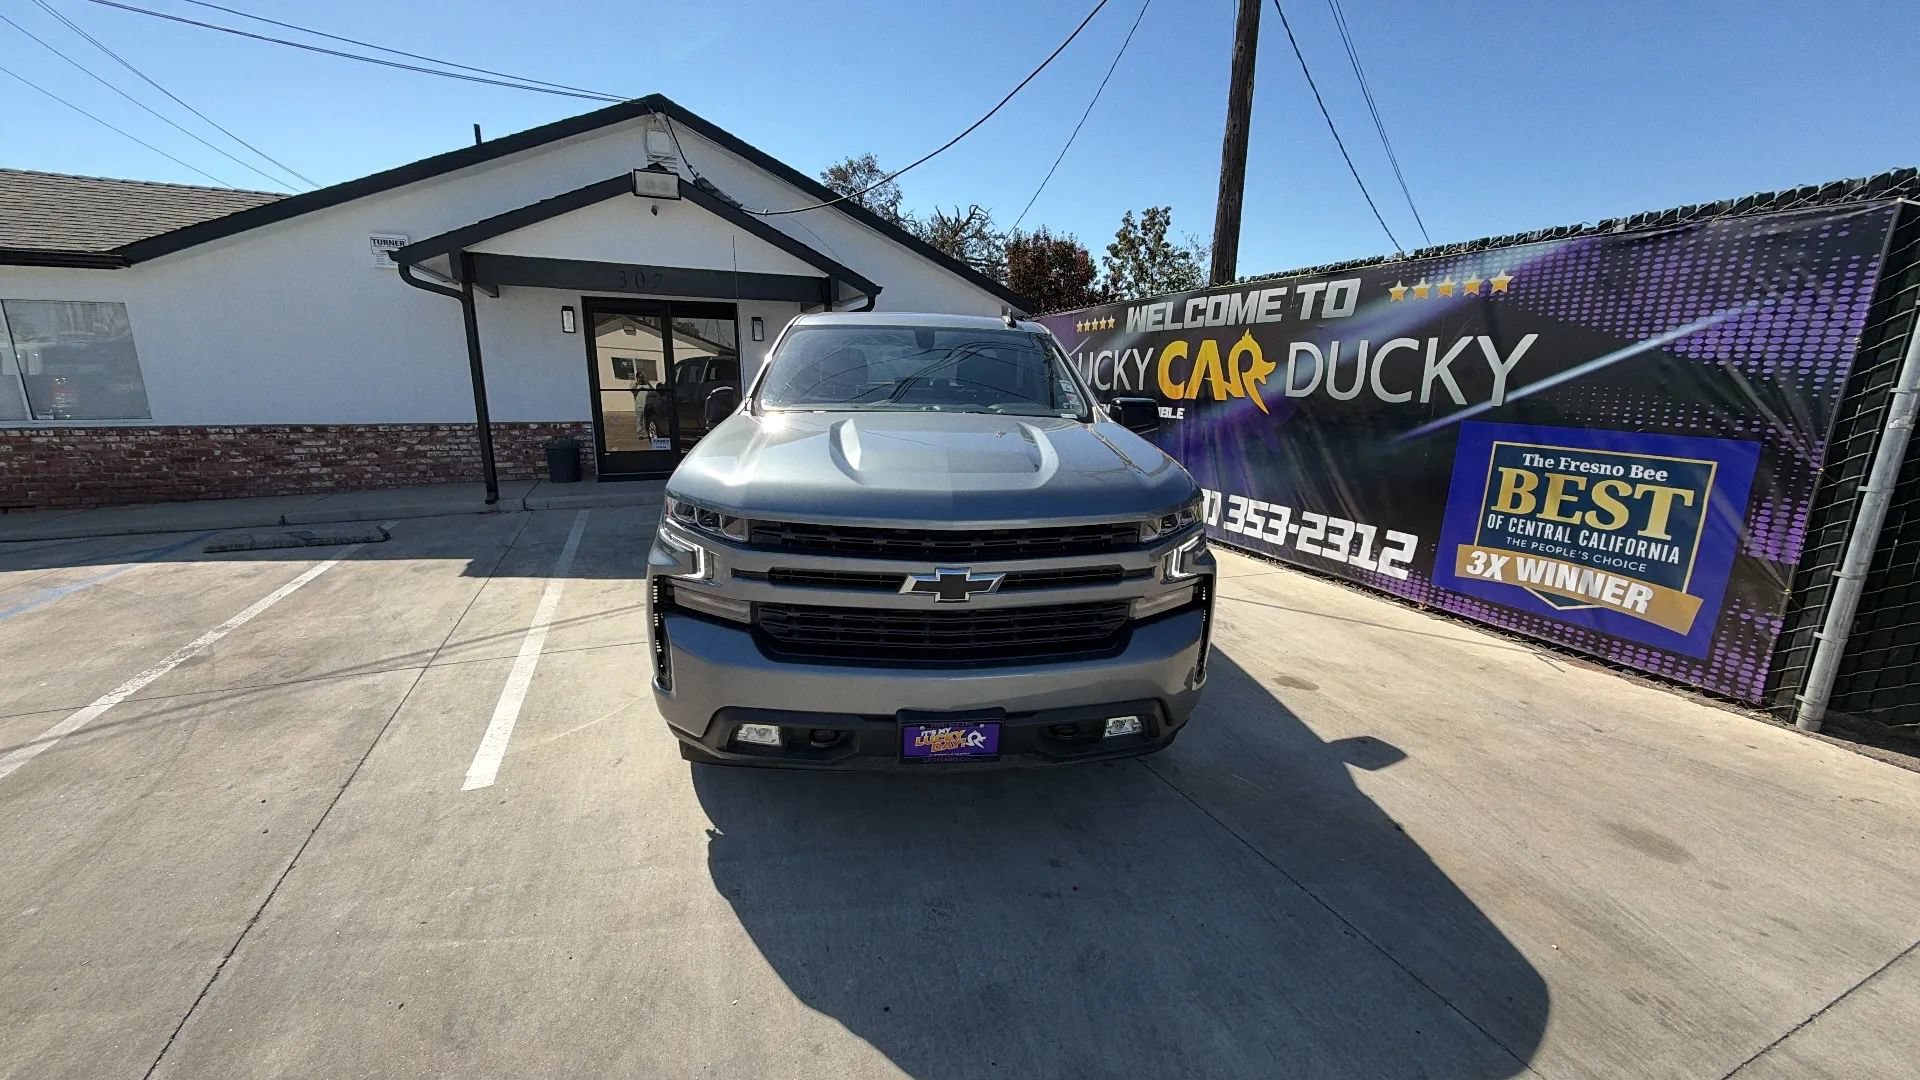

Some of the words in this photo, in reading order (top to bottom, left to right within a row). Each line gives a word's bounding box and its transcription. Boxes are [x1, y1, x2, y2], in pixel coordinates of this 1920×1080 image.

[371, 238, 405, 247] TURNER
[617, 270, 664, 289] 307
[1126, 287, 1287, 334] WELCOME
[1297, 278, 1361, 320] TO
[1077, 347, 1154, 391] UCKY
[1158, 328, 1276, 415] CAR
[1285, 334, 1538, 406] DUCKY
[1523, 453, 1554, 469] The
[1558, 457, 1624, 477] Fresno
[1629, 465, 1668, 482] Bee
[1491, 467, 1695, 541] BEST
[1224, 494, 1418, 580] 353-2312
[1487, 514, 1503, 529] OF
[1508, 518, 1572, 544] CENTRAL
[1579, 529, 1680, 565] CALIFORNIA
[1506, 536, 1527, 548] THE
[1531, 541, 1589, 560] PEOPLE'S
[1593, 553, 1647, 573] CHOICE
[1466, 550, 1511, 581] 3X
[1516, 556, 1654, 615] WINNER
[915, 729, 966, 746] LUCKY
[938, 727, 952, 735] MY
